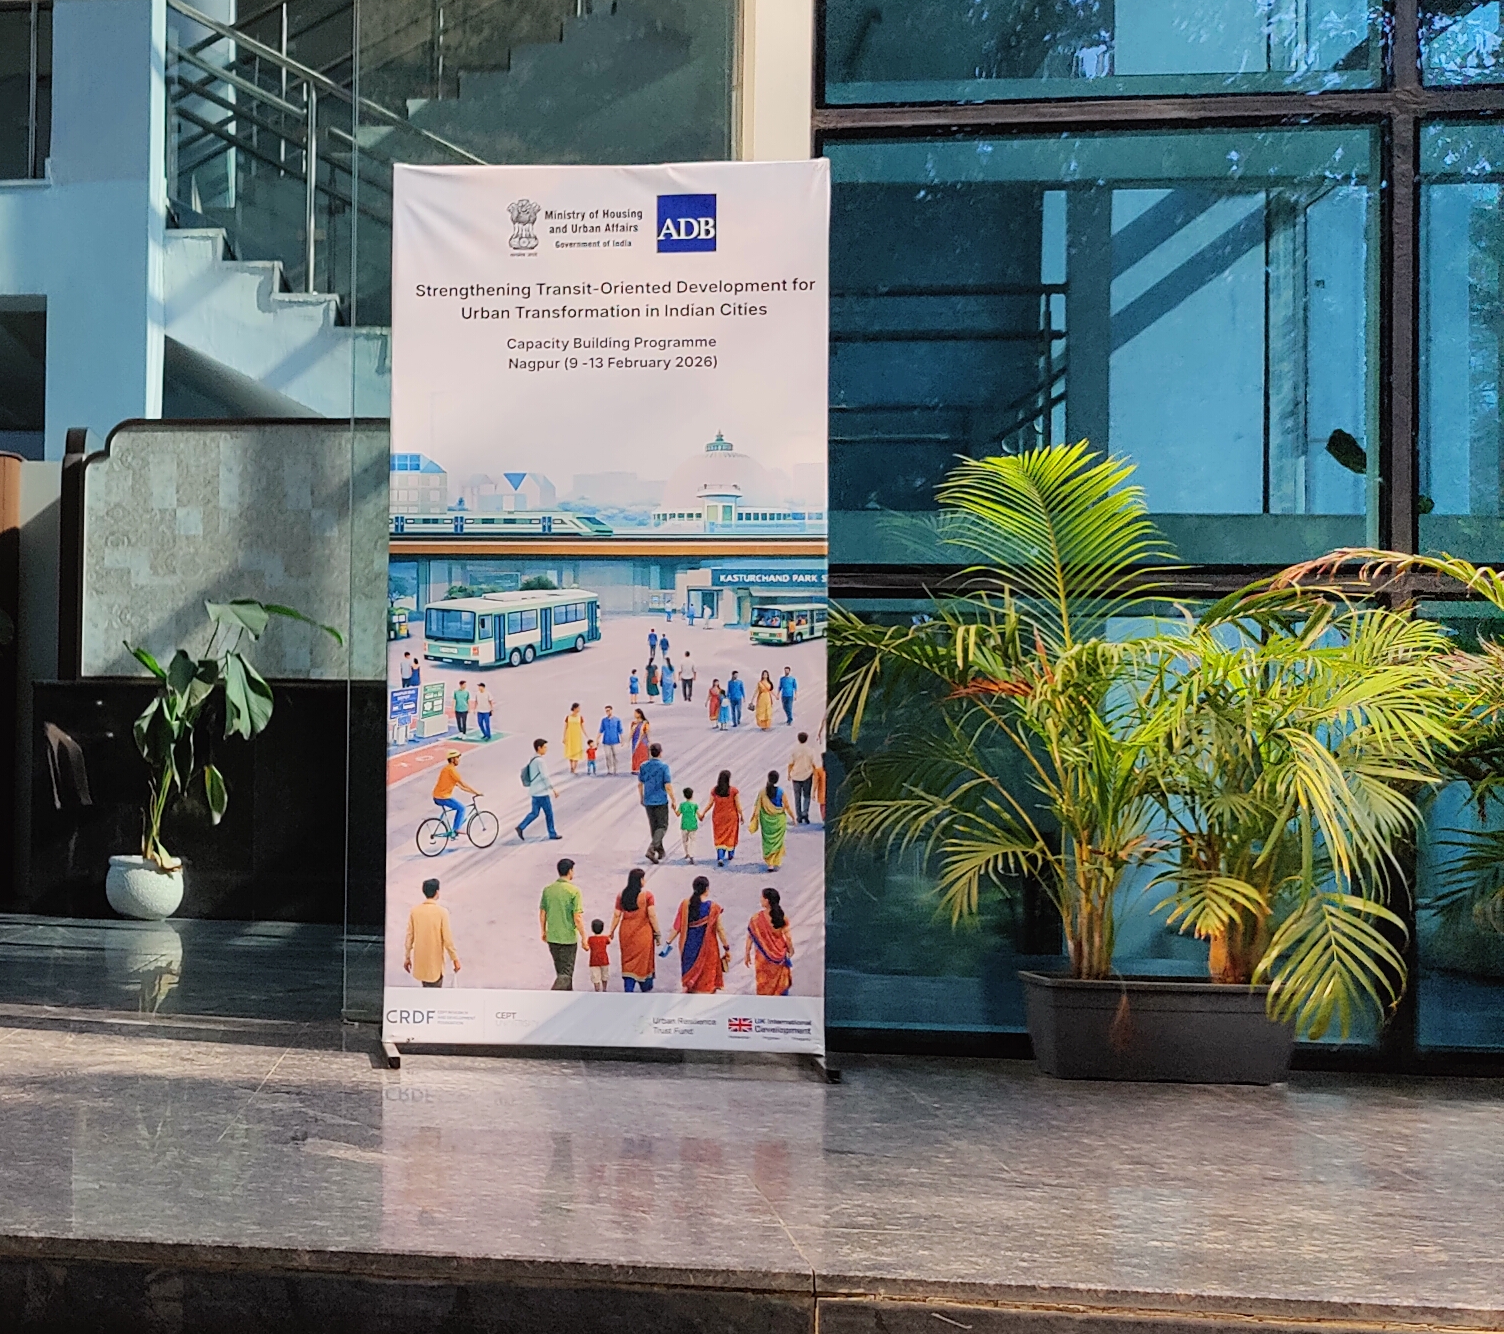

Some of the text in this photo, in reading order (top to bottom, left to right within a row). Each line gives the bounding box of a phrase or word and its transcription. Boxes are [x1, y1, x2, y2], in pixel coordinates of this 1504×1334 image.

[544, 208, 644, 223] Ministry of Housing
[549, 222, 639, 234] and Urban Affairs
[657, 218, 716, 240] ADB
[555, 239, 632, 249] Government of India
[416, 277, 816, 300] Strengthening Transit-Oriented Development for
[461, 302, 767, 320] Urban Transformation in Indian Cities
[507, 336, 717, 352] Capacity Building Programme
[508, 355, 718, 372] Nagpur (9 -13 February 2026)
[720, 574, 790, 583] KASTURCHAND
[792, 574, 818, 583] PARK
[386, 1009, 436, 1025] CRDF
[495, 1011, 517, 1020] CEPT
